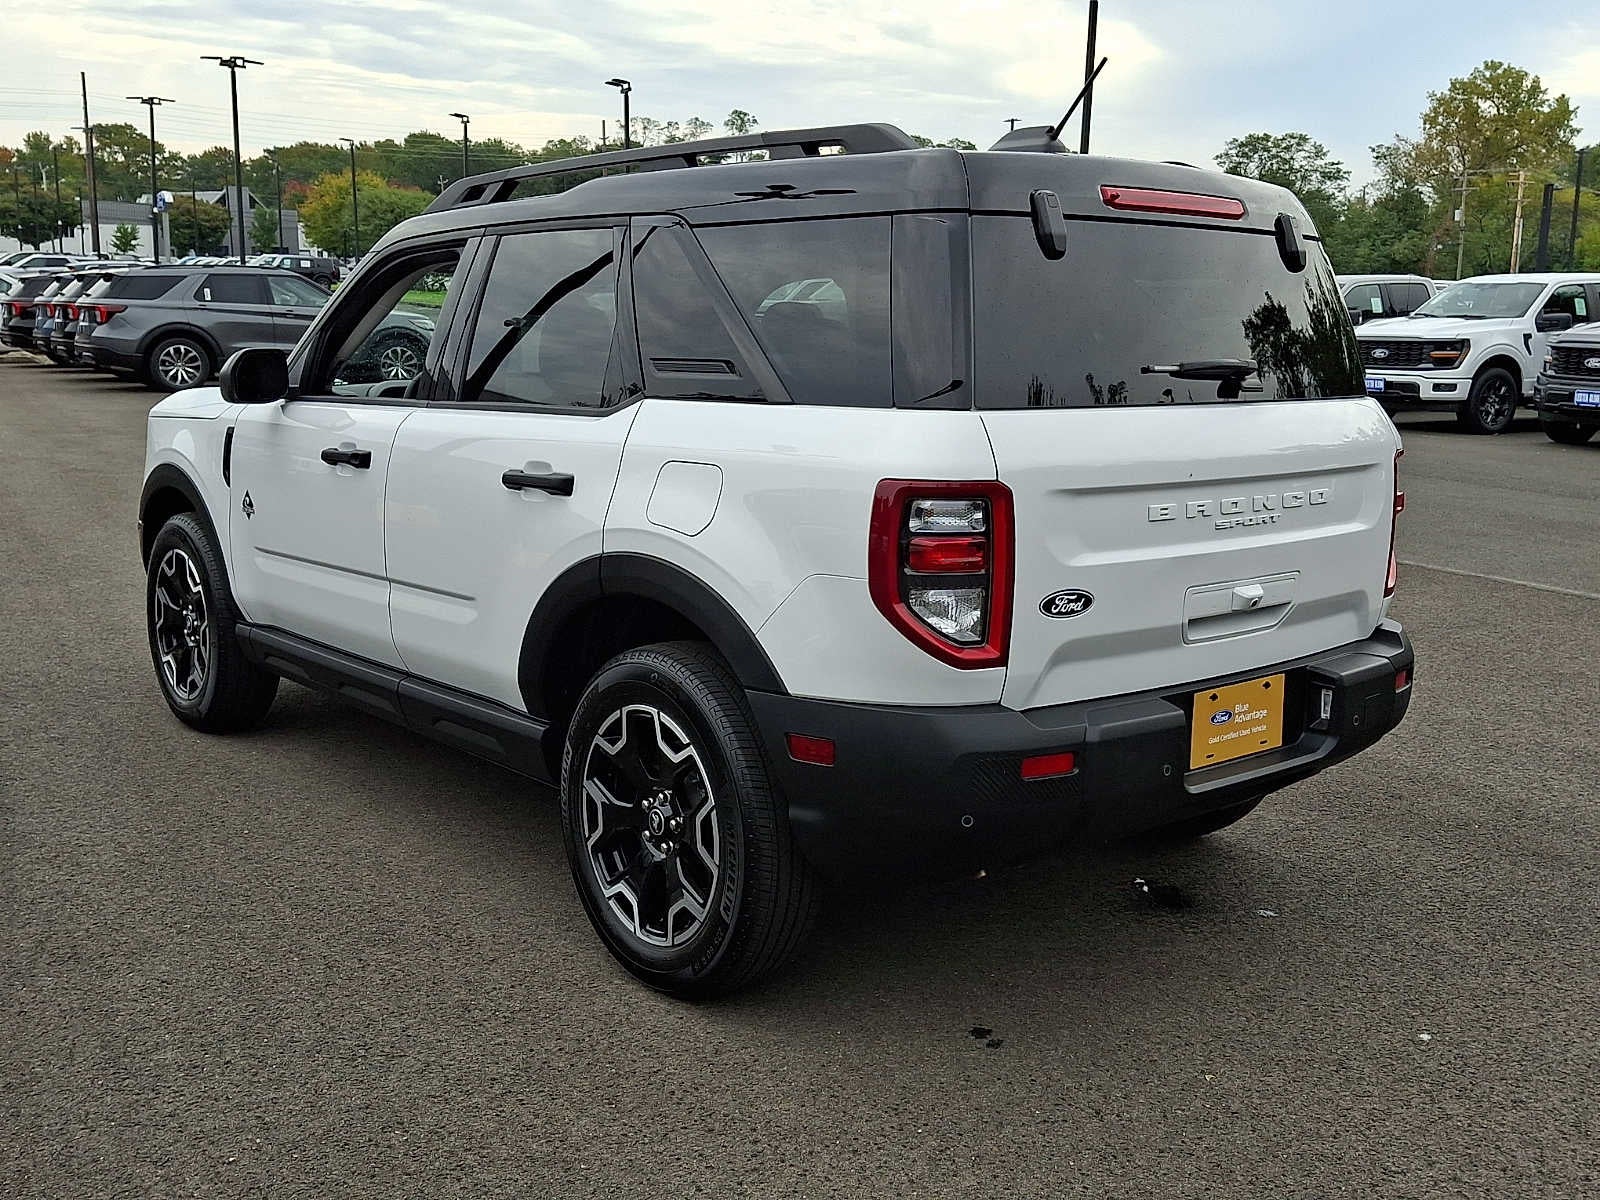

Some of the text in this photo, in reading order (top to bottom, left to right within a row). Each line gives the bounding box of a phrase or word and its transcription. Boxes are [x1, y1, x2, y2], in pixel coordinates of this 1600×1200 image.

[1148, 488, 1329, 522] BRONCO
[1214, 513, 1281, 530] SPORT
[1051, 594, 1086, 614] Ford
[1234, 703, 1249, 714] Blue
